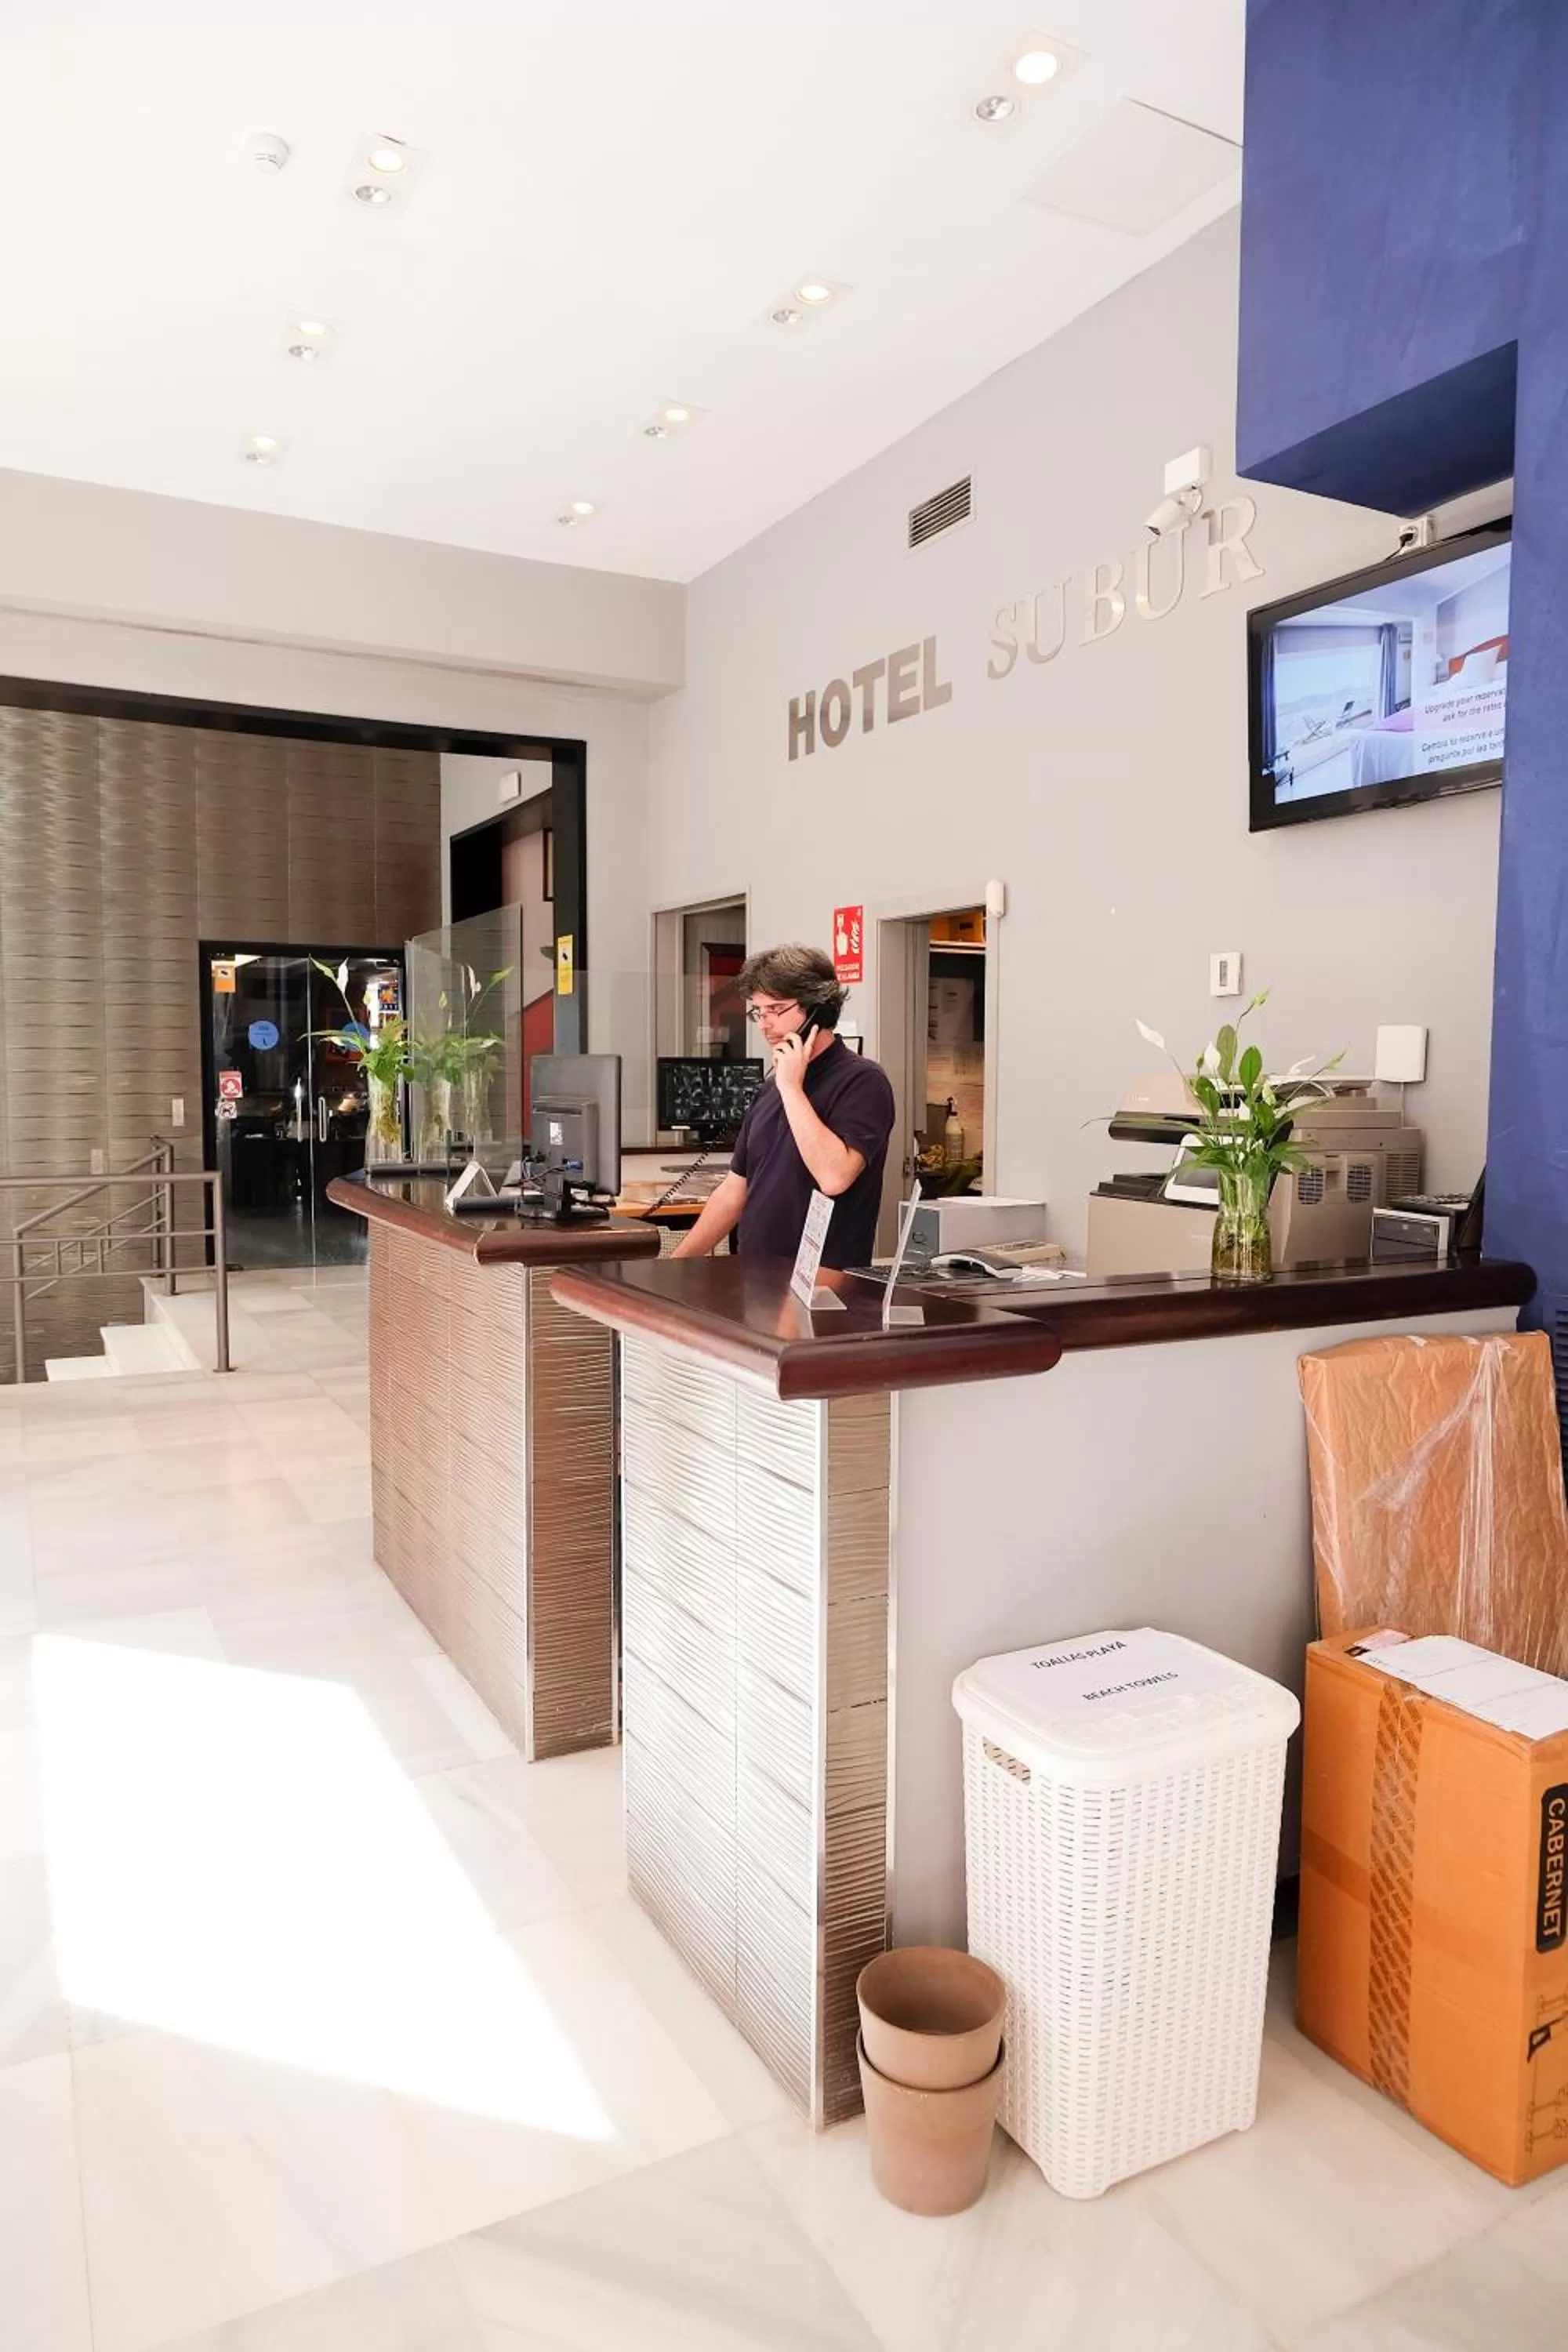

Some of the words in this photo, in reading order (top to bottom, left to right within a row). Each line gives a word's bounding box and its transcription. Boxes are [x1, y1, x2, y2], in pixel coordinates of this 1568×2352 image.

[788, 634, 953, 761] HOTEL
[987, 495, 1265, 680] SUBUR
[1030, 1652, 1087, 1670] TOALLAS
[1087, 1640, 1127, 1658] PLAYA
[1082, 1683, 1127, 1700] BEACH
[1126, 1671, 1178, 1689] TOWELS
[1543, 1798, 1566, 1937] CABERNET
